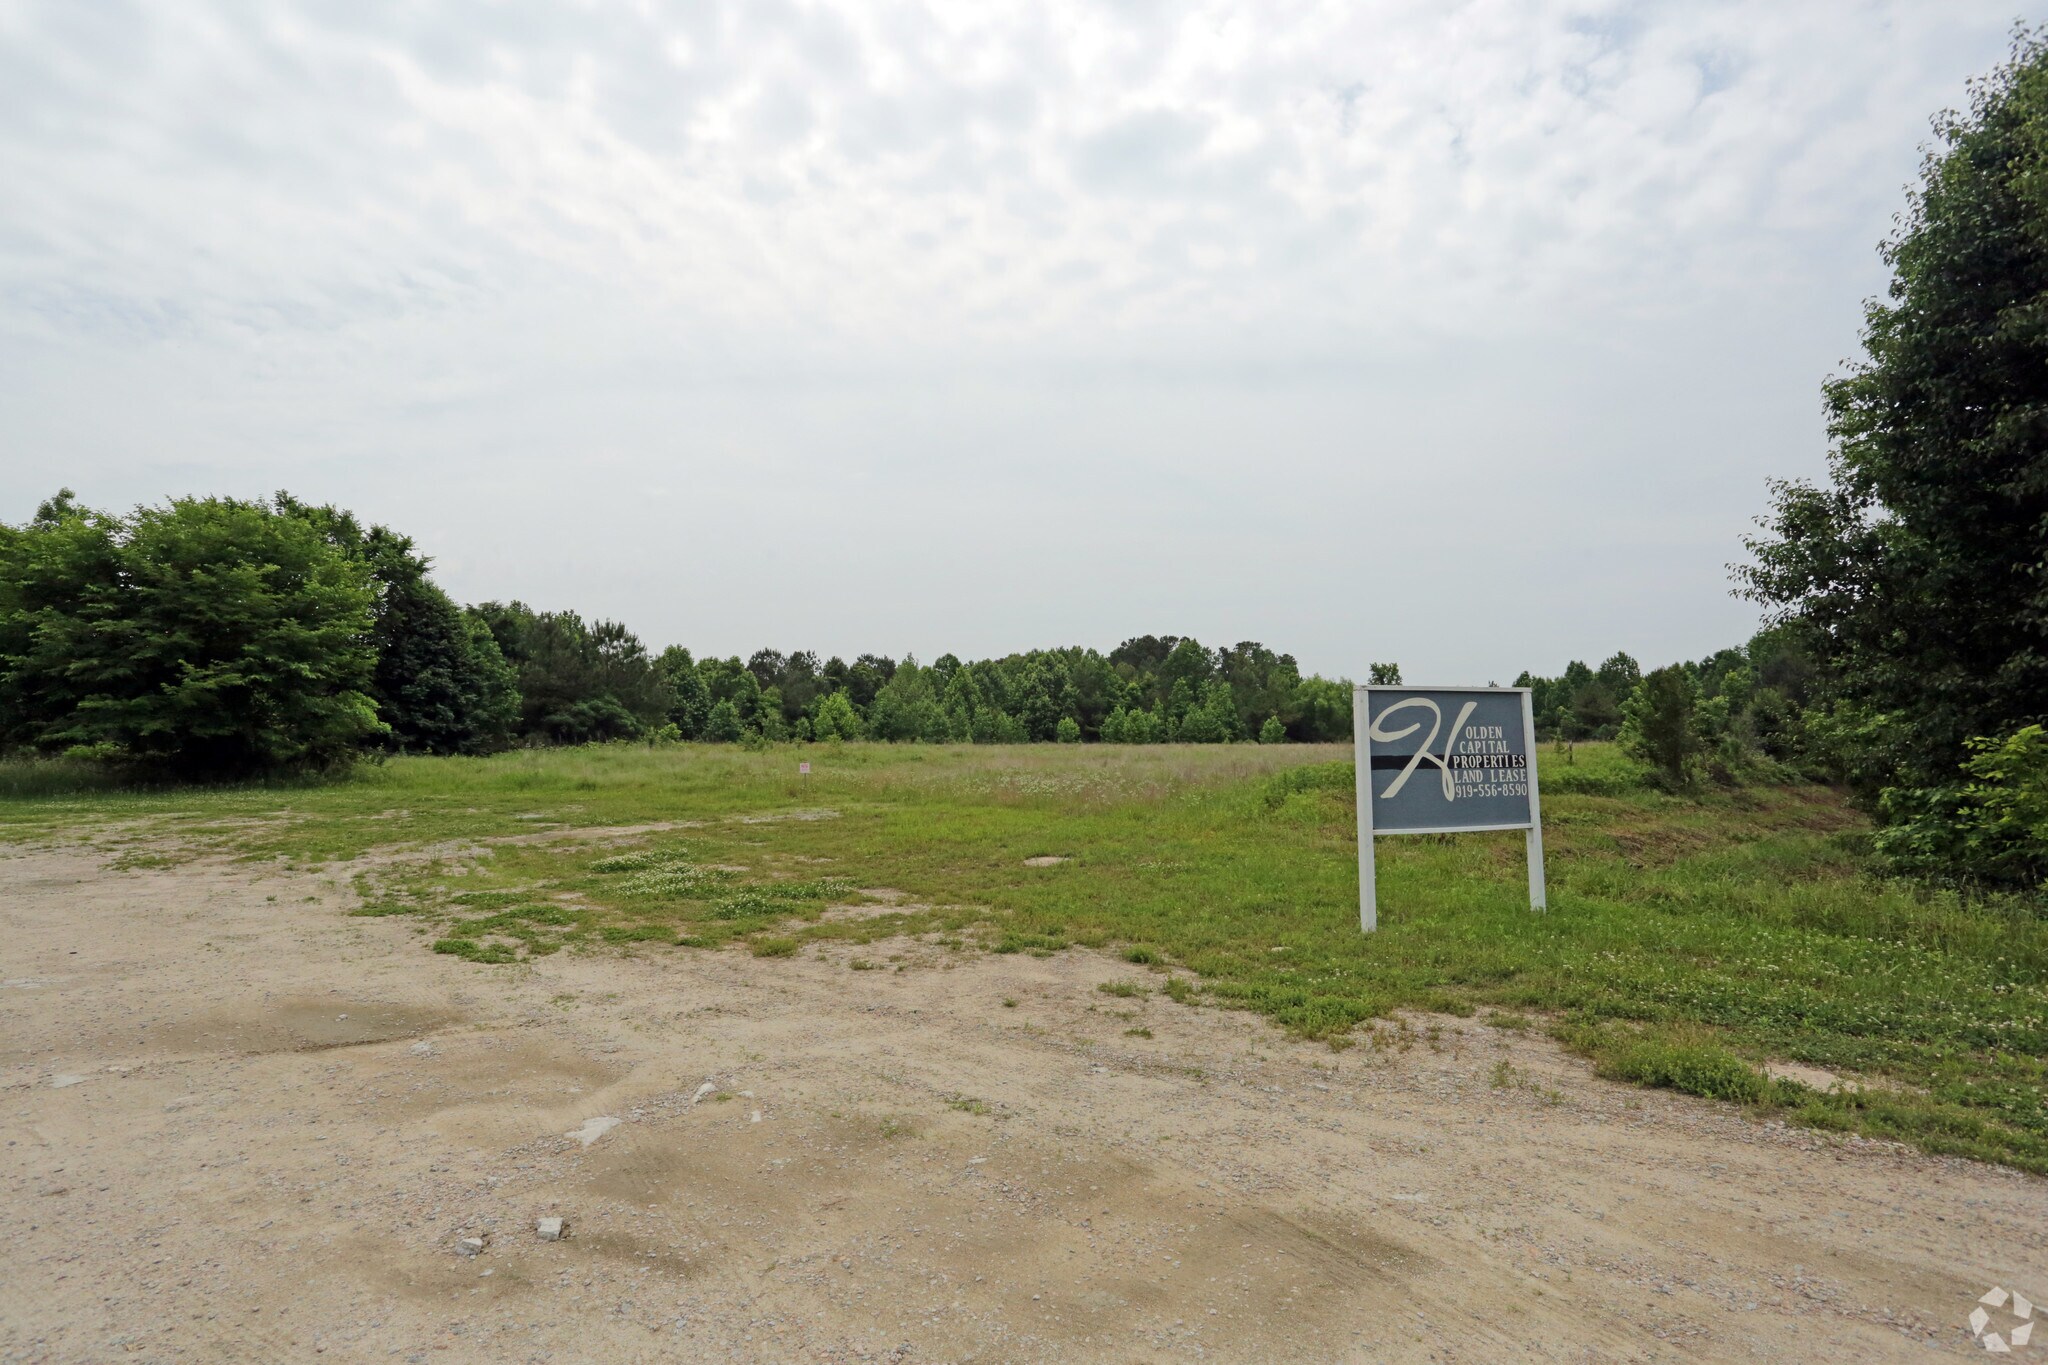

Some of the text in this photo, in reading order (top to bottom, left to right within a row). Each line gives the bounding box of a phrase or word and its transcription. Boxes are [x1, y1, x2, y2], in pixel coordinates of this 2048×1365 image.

[1459, 740, 1510, 754] CAPITAL
[1453, 754, 1526, 769] PROPERTIES
[1454, 768, 1527, 783] LAND LEASE
[1455, 783, 1528, 798] 919-556-8590
